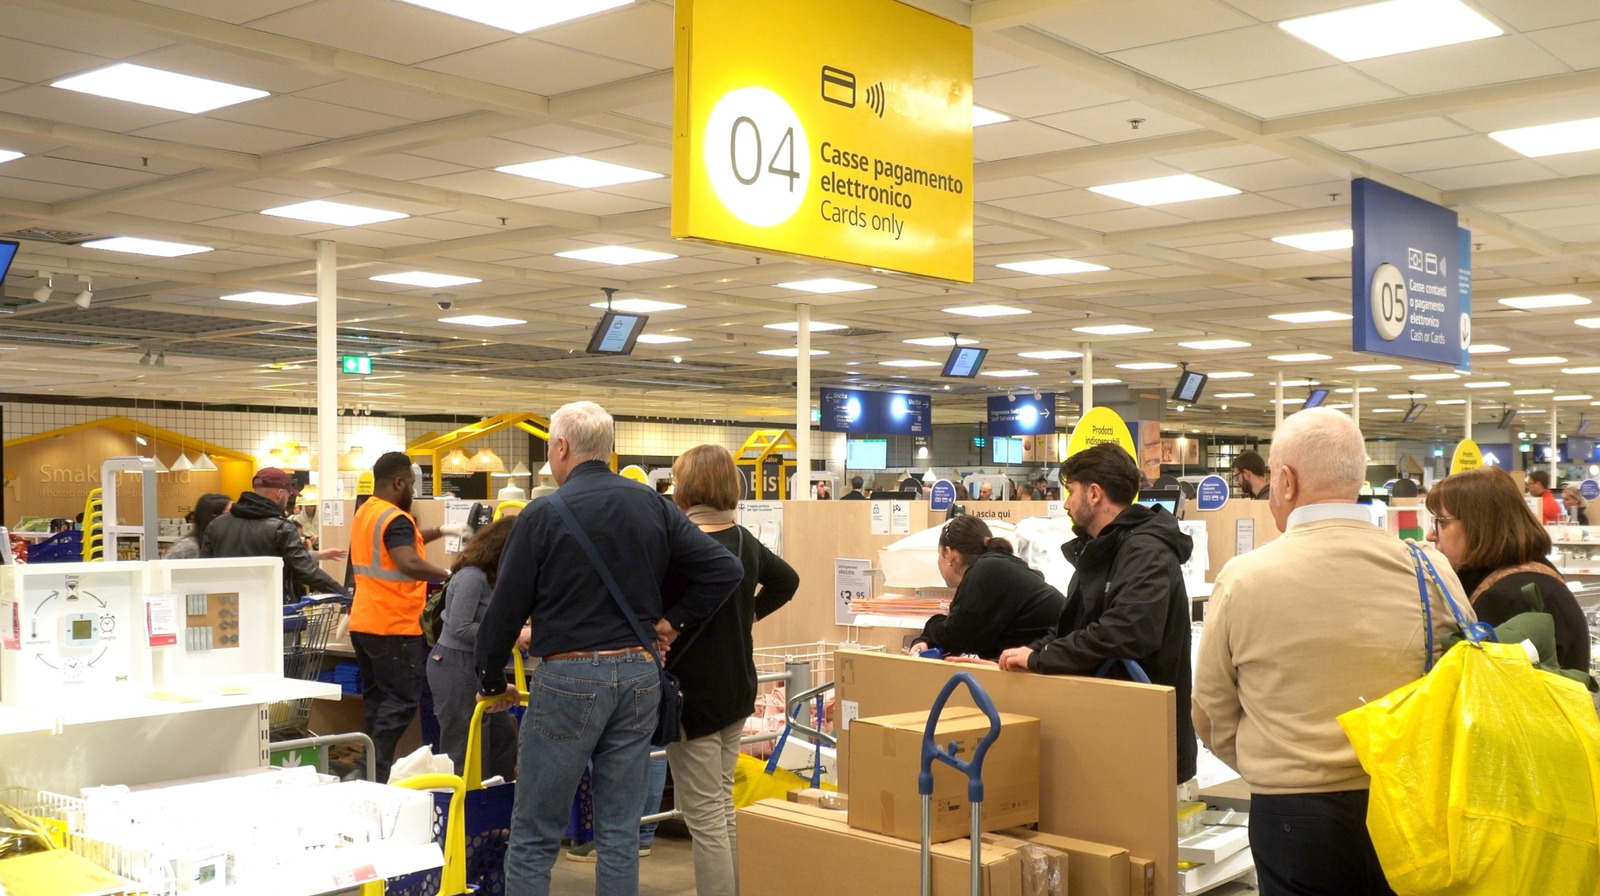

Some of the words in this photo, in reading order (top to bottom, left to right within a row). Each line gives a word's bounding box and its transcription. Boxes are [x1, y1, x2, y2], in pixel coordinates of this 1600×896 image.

[730, 115, 800, 193] 04
[820, 141, 869, 172] Casse
[874, 158, 963, 195] pagamento
[820, 171, 912, 210] elettronico
[820, 199, 867, 228] Cards
[871, 213, 904, 240] only
[1409, 279, 1425, 293] Casse
[1425, 284, 1447, 297] contanti
[1382, 282, 1405, 322] 05
[1409, 298, 1414, 307] o
[1414, 298, 1445, 312] pagamento
[1410, 313, 1440, 327] elettronico
[1410, 329, 1424, 342] Cash
[1424, 333, 1430, 342] or
[1430, 331, 1446, 344] Cards
[833, 392, 848, 400] Uscita
[1092, 425, 1114, 435] Prodotti
[972, 510, 996, 518] Lascia
[998, 510, 1011, 520] qui
